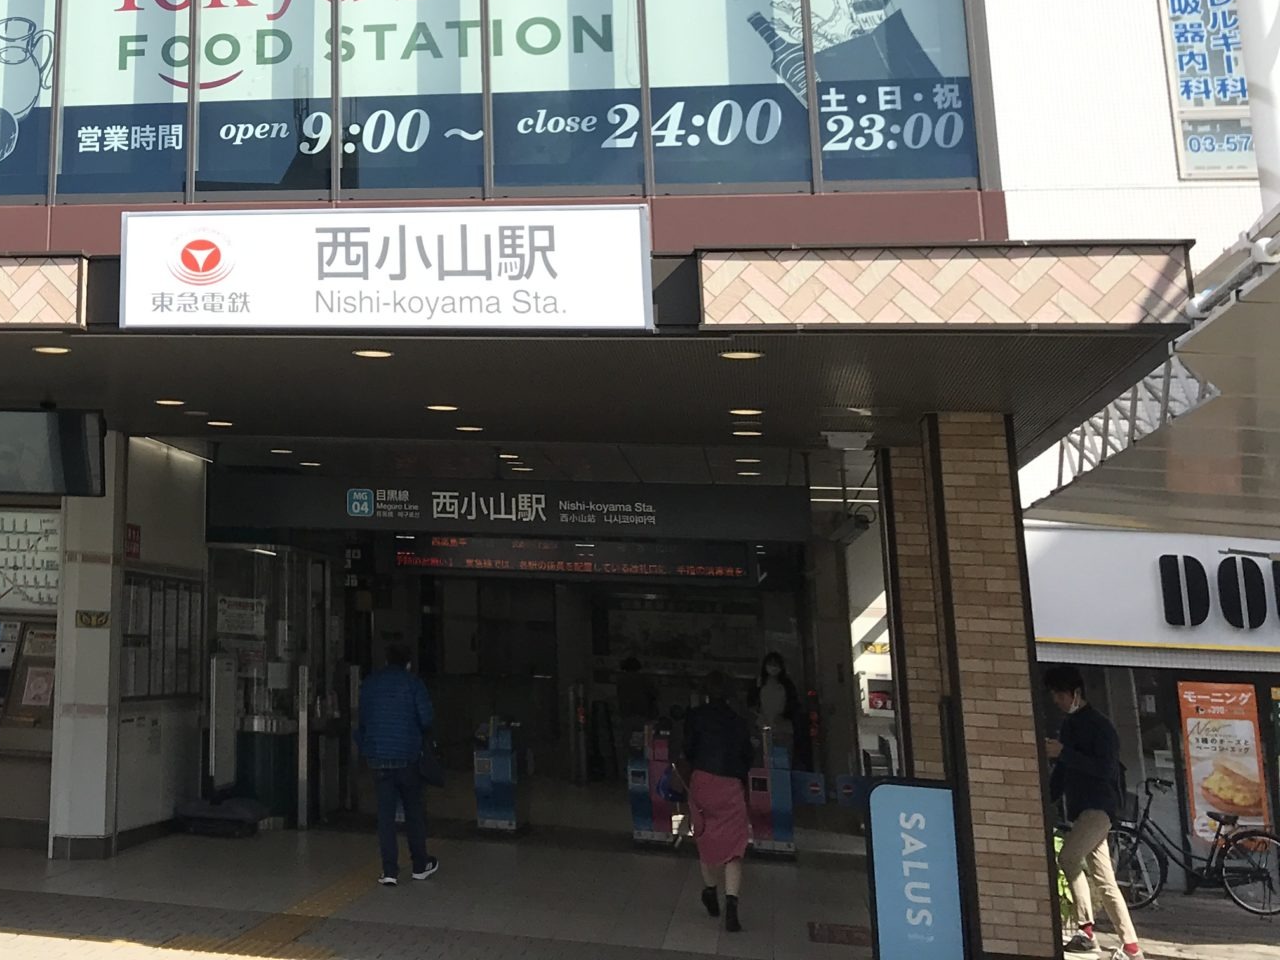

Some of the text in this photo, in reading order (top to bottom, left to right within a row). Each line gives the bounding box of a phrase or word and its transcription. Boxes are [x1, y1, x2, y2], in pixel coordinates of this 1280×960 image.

[118, 14, 613, 71] FOOD STATION
[77, 124, 183, 153] 営業時間
[220, 122, 289, 145] open
[300, 108, 430, 155] 9:00
[517, 109, 597, 136] close
[602, 98, 781, 150] 24:00
[822, 111, 964, 151] 23:00
[1187, 134, 1254, 153] 03-57
[315, 223, 558, 282] 西小山駅
[151, 291, 251, 313] 東急電鉄
[315, 289, 567, 321] Nishi-koyama Sta.
[352, 501, 369, 514] 04
[353, 491, 368, 501] MG
[376, 489, 409, 502] 目黒線
[431, 491, 547, 522] 西小山駅
[559, 500, 656, 514] Nishi-koyama Sta.
[1159, 554, 1280, 629] DO
[1183, 691, 1252, 706] モーニング
[899, 812, 933, 927] SALUS
